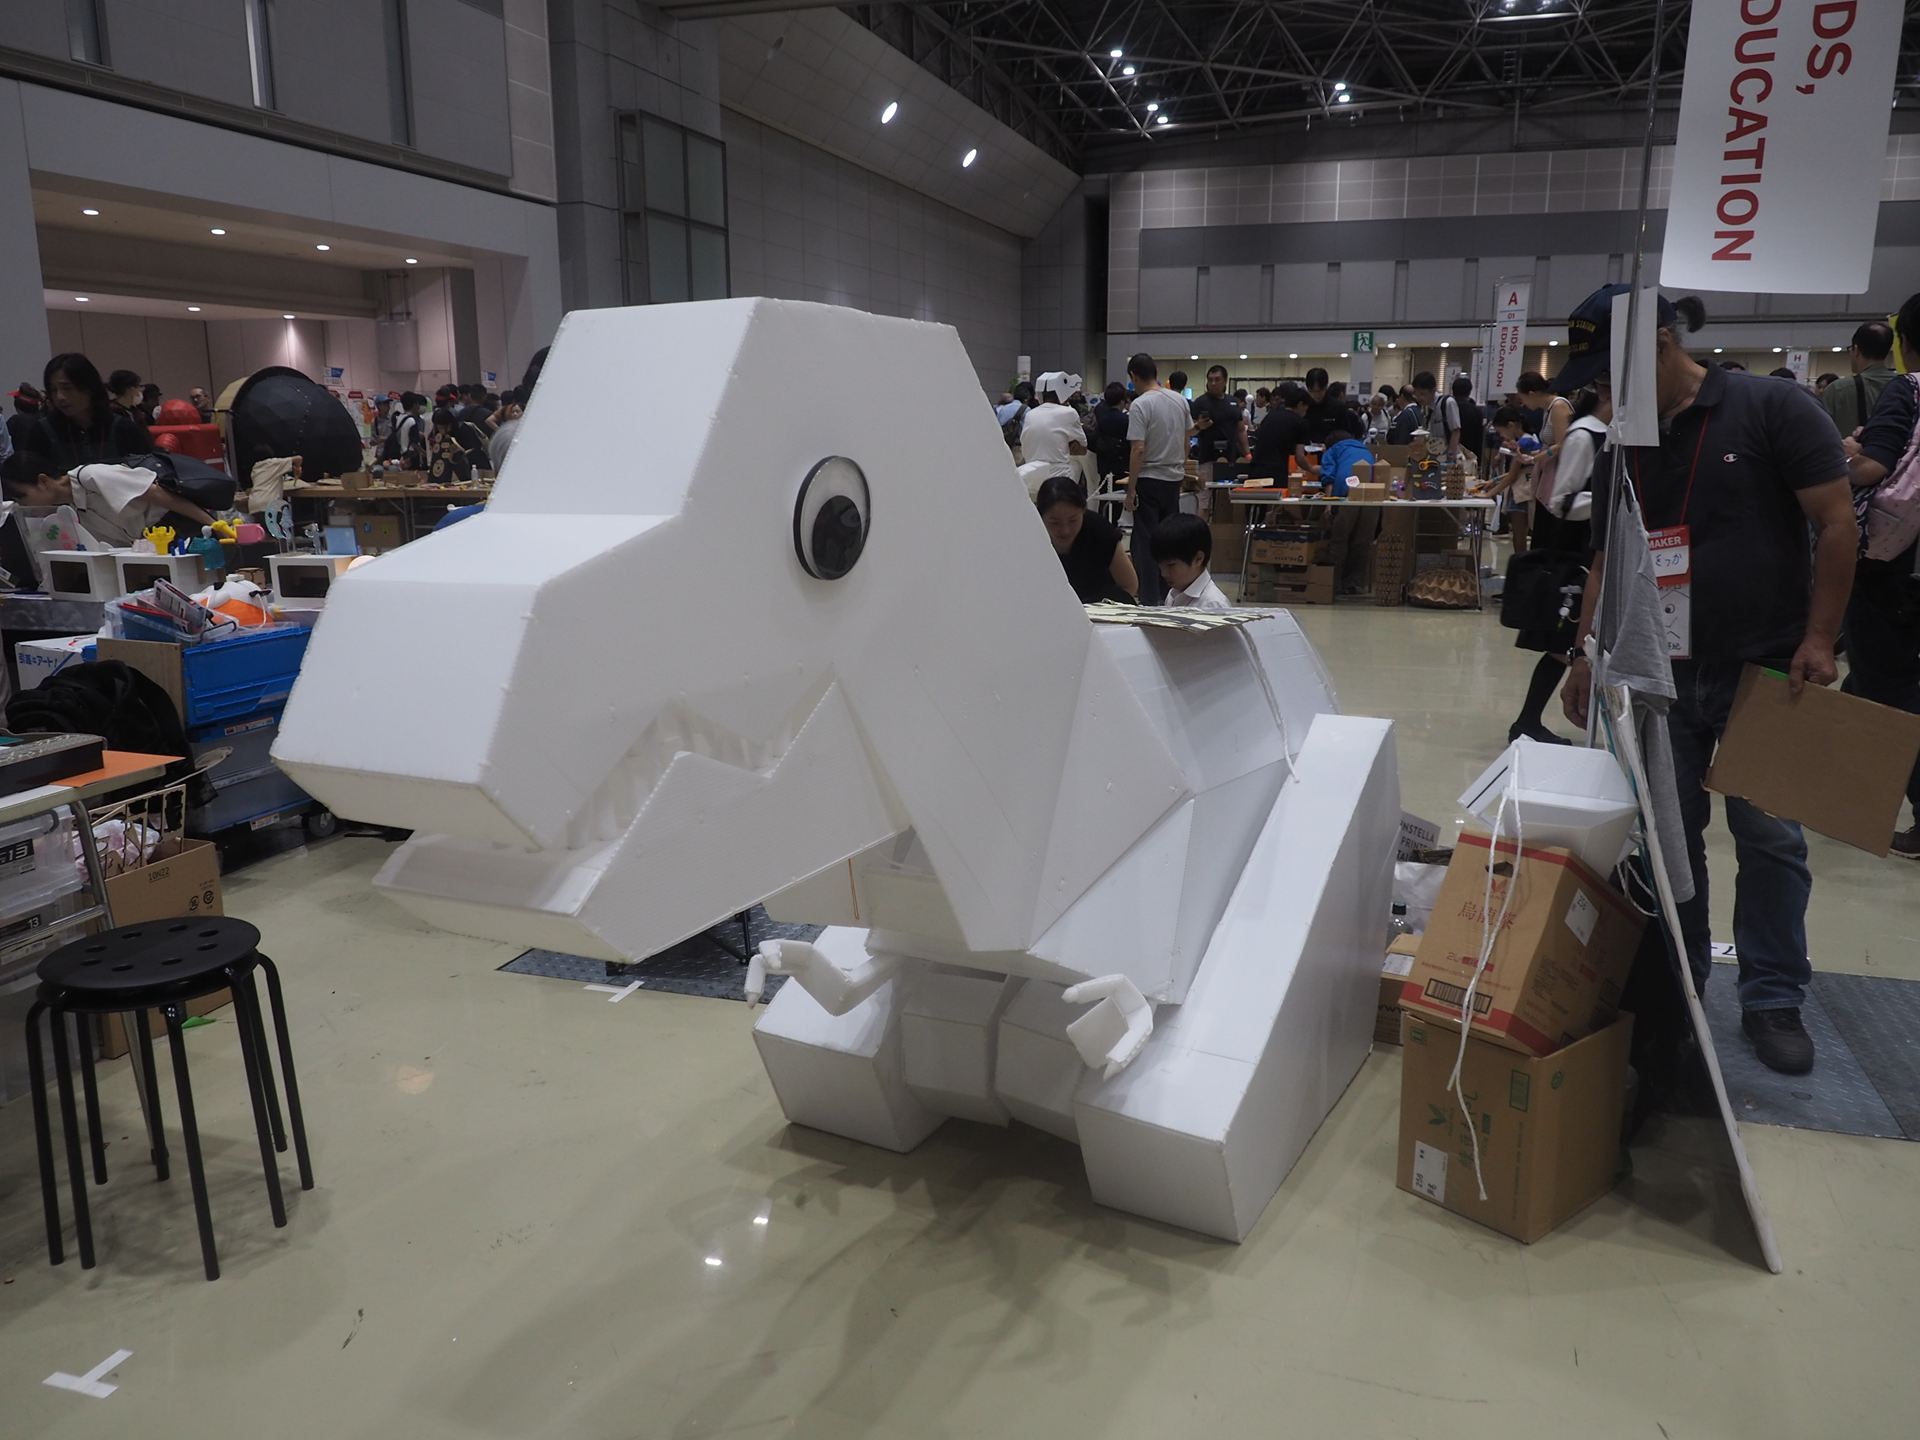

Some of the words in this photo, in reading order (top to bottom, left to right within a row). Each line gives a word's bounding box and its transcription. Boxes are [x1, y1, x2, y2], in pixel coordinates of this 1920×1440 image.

[1508, 291, 1518, 306] A
[1508, 326, 1520, 355] KIDS,
[1496, 327, 1508, 387] EDUCATION
[1648, 536, 1682, 550] MAKER
[28, 917, 40, 929] 13
